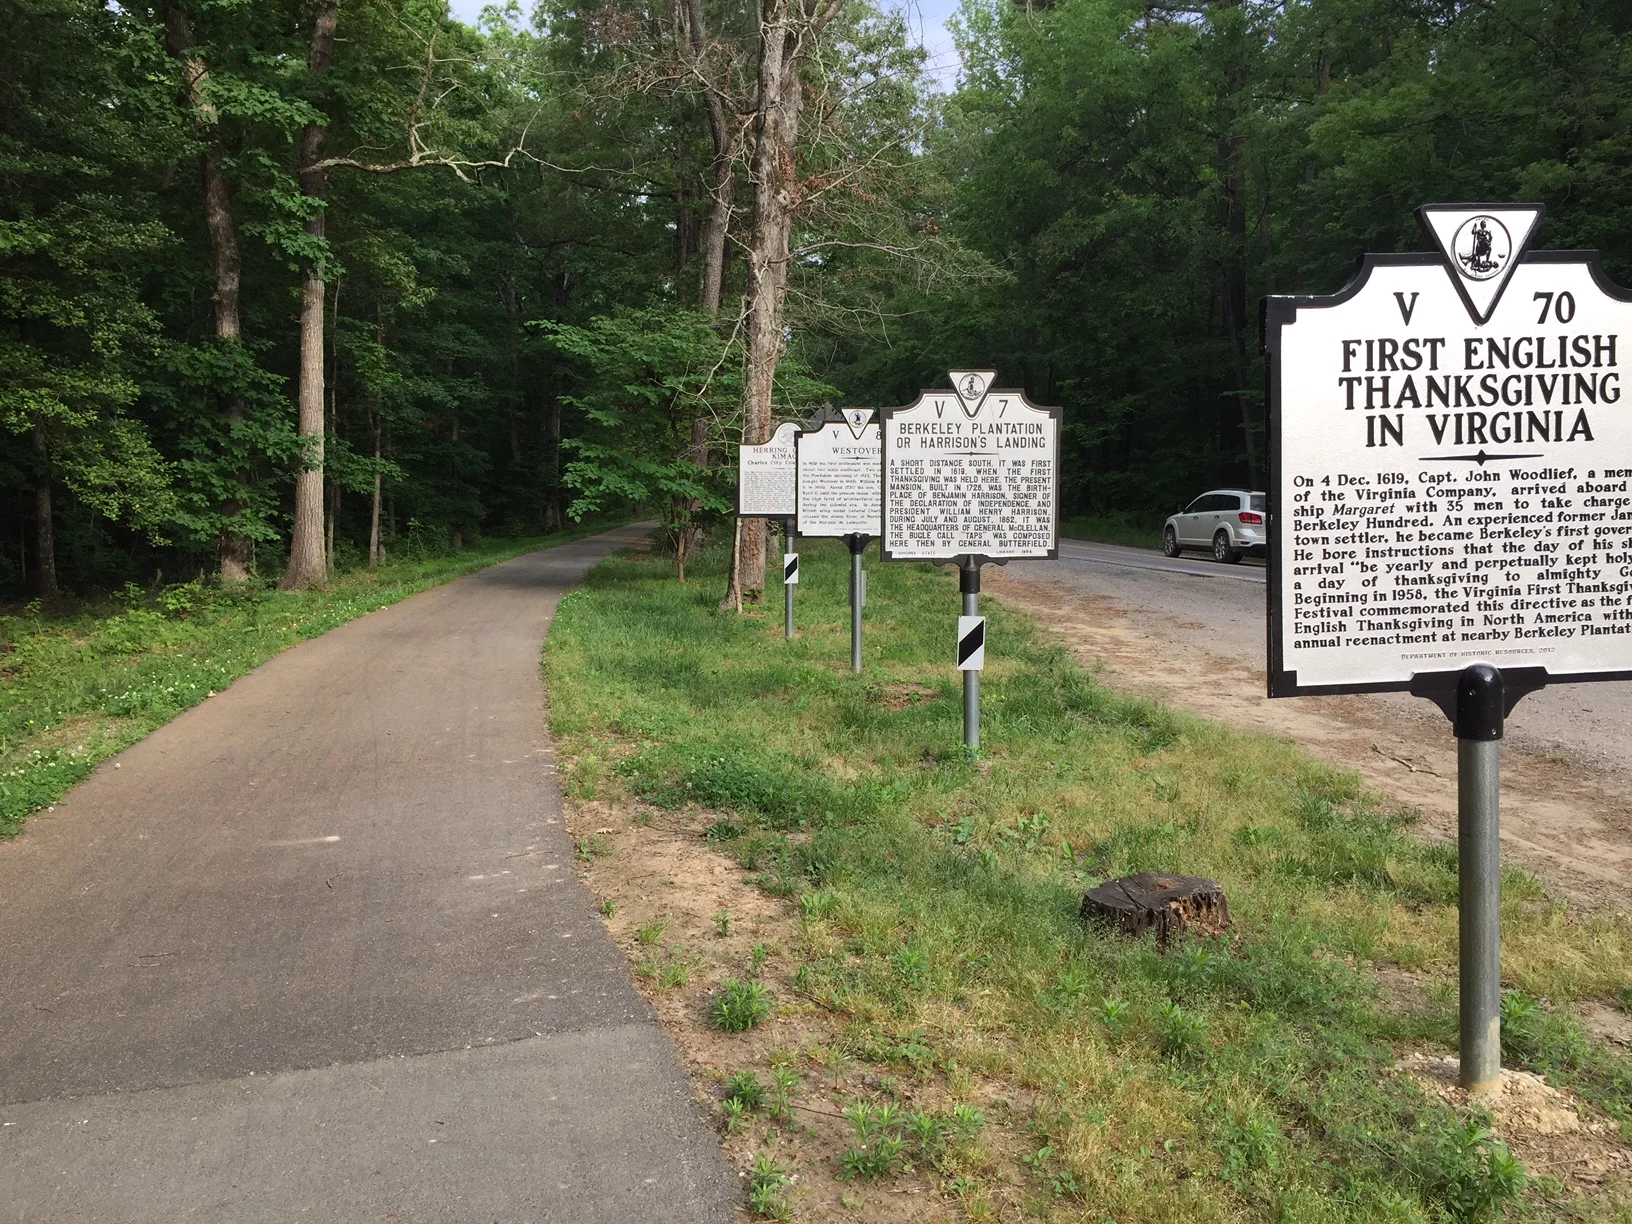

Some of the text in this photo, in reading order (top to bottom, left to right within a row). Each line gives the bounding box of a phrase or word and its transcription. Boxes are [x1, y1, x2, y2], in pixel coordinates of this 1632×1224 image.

[1393, 291, 1576, 326] V 70
[1342, 335, 1618, 373] FIRST ENGLISH
[1339, 373, 1621, 411] THANKSGIVING
[935, 400, 1008, 419] V 7
[833, 431, 840, 439] V
[900, 423, 1042, 435] BERKELEY PLANTATION
[1366, 408, 1595, 448] IN VIRGINIA
[897, 437, 1046, 449] OR HARRISON'S LANDING
[890, 467, 925, 475] SETTLED
[976, 468, 998, 476] WHEN
[1030, 468, 1052, 476] FIRST
[930, 459, 963, 467] DISTANCE
[1012, 460, 1026, 468] WAS
[1032, 460, 1052, 468] FIRST
[890, 475, 941, 483] THANKSGIVING
[960, 476, 979, 484] HELD
[1004, 476, 1018, 484] THE
[1021, 476, 1052, 484] PRESENT
[988, 484, 1003, 492] WAS
[1294, 476, 1314, 488] On
[1321, 475, 1331, 487] 4
[1338, 474, 1370, 486] Dec.
[1377, 473, 1409, 485] 1619,
[1418, 471, 1457, 486] Capt.
[1466, 470, 1501, 482] John
[1509, 468, 1578, 481] Woodlief,
[1588, 470, 1596, 479] a
[890, 491, 913, 499] PLACE
[932, 492, 967, 500] BENJAMIN
[1294, 481, 1627, 503] of the Virginia Company, arrived aboard
[890, 508, 931, 516] PRESIDENT
[940, 508, 971, 516] WILLIAM
[979, 508, 1003, 516] HENRY
[910, 500, 958, 508] DECLARATION
[1037, 500, 1051, 508] AND
[1294, 496, 1631, 520] ship Margaret with 35 men to take charge
[890, 515, 916, 523] DURING
[1036, 516, 1051, 524] WAS
[907, 524, 959, 532] HEADQUARTERS
[974, 524, 1006, 532] GENERAL
[1294, 511, 1606, 532] Berkeley Hundred. An experienced former
[916, 540, 935, 548] THEN
[958, 540, 992, 548] GENERAL
[999, 540, 1052, 548] BUTTERFIELD.
[937, 532, 955, 540] CALL
[1013, 532, 1051, 540] COMPOSED
[1294, 534, 1330, 546] town
[1335, 532, 1389, 545] settler,
[1396, 531, 1414, 543] he
[1418, 530, 1474, 542] became
[1480, 526, 1552, 540] Berkeley's
[1557, 525, 1590, 537] first
[1294, 538, 1614, 561] He bore instructions that the day of his
[1294, 562, 1344, 576] arrival
[1386, 560, 1434, 574] yearly
[1442, 558, 1468, 570] and
[1475, 555, 1559, 572] perpetually
[1566, 553, 1598, 568] kept
[1294, 568, 1602, 590] a day of thanksgiving to almighty
[1295, 592, 1368, 607] Beginning
[1373, 590, 1387, 602] in
[1392, 589, 1428, 601] 1958,
[1434, 588, 1458, 599] the
[1462, 585, 1522, 600] Virginia
[1527, 583, 1562, 596] First
[1294, 596, 1622, 620] Festival commemorated this directive as the
[1294, 608, 1632, 636] English Thanksgiving in North America with
[1294, 636, 1341, 649] annual
[1346, 632, 1437, 647] reenactment
[1442, 631, 1456, 642] at
[1461, 629, 1511, 642] nearby
[1514, 626, 1576, 639] Berkeley
